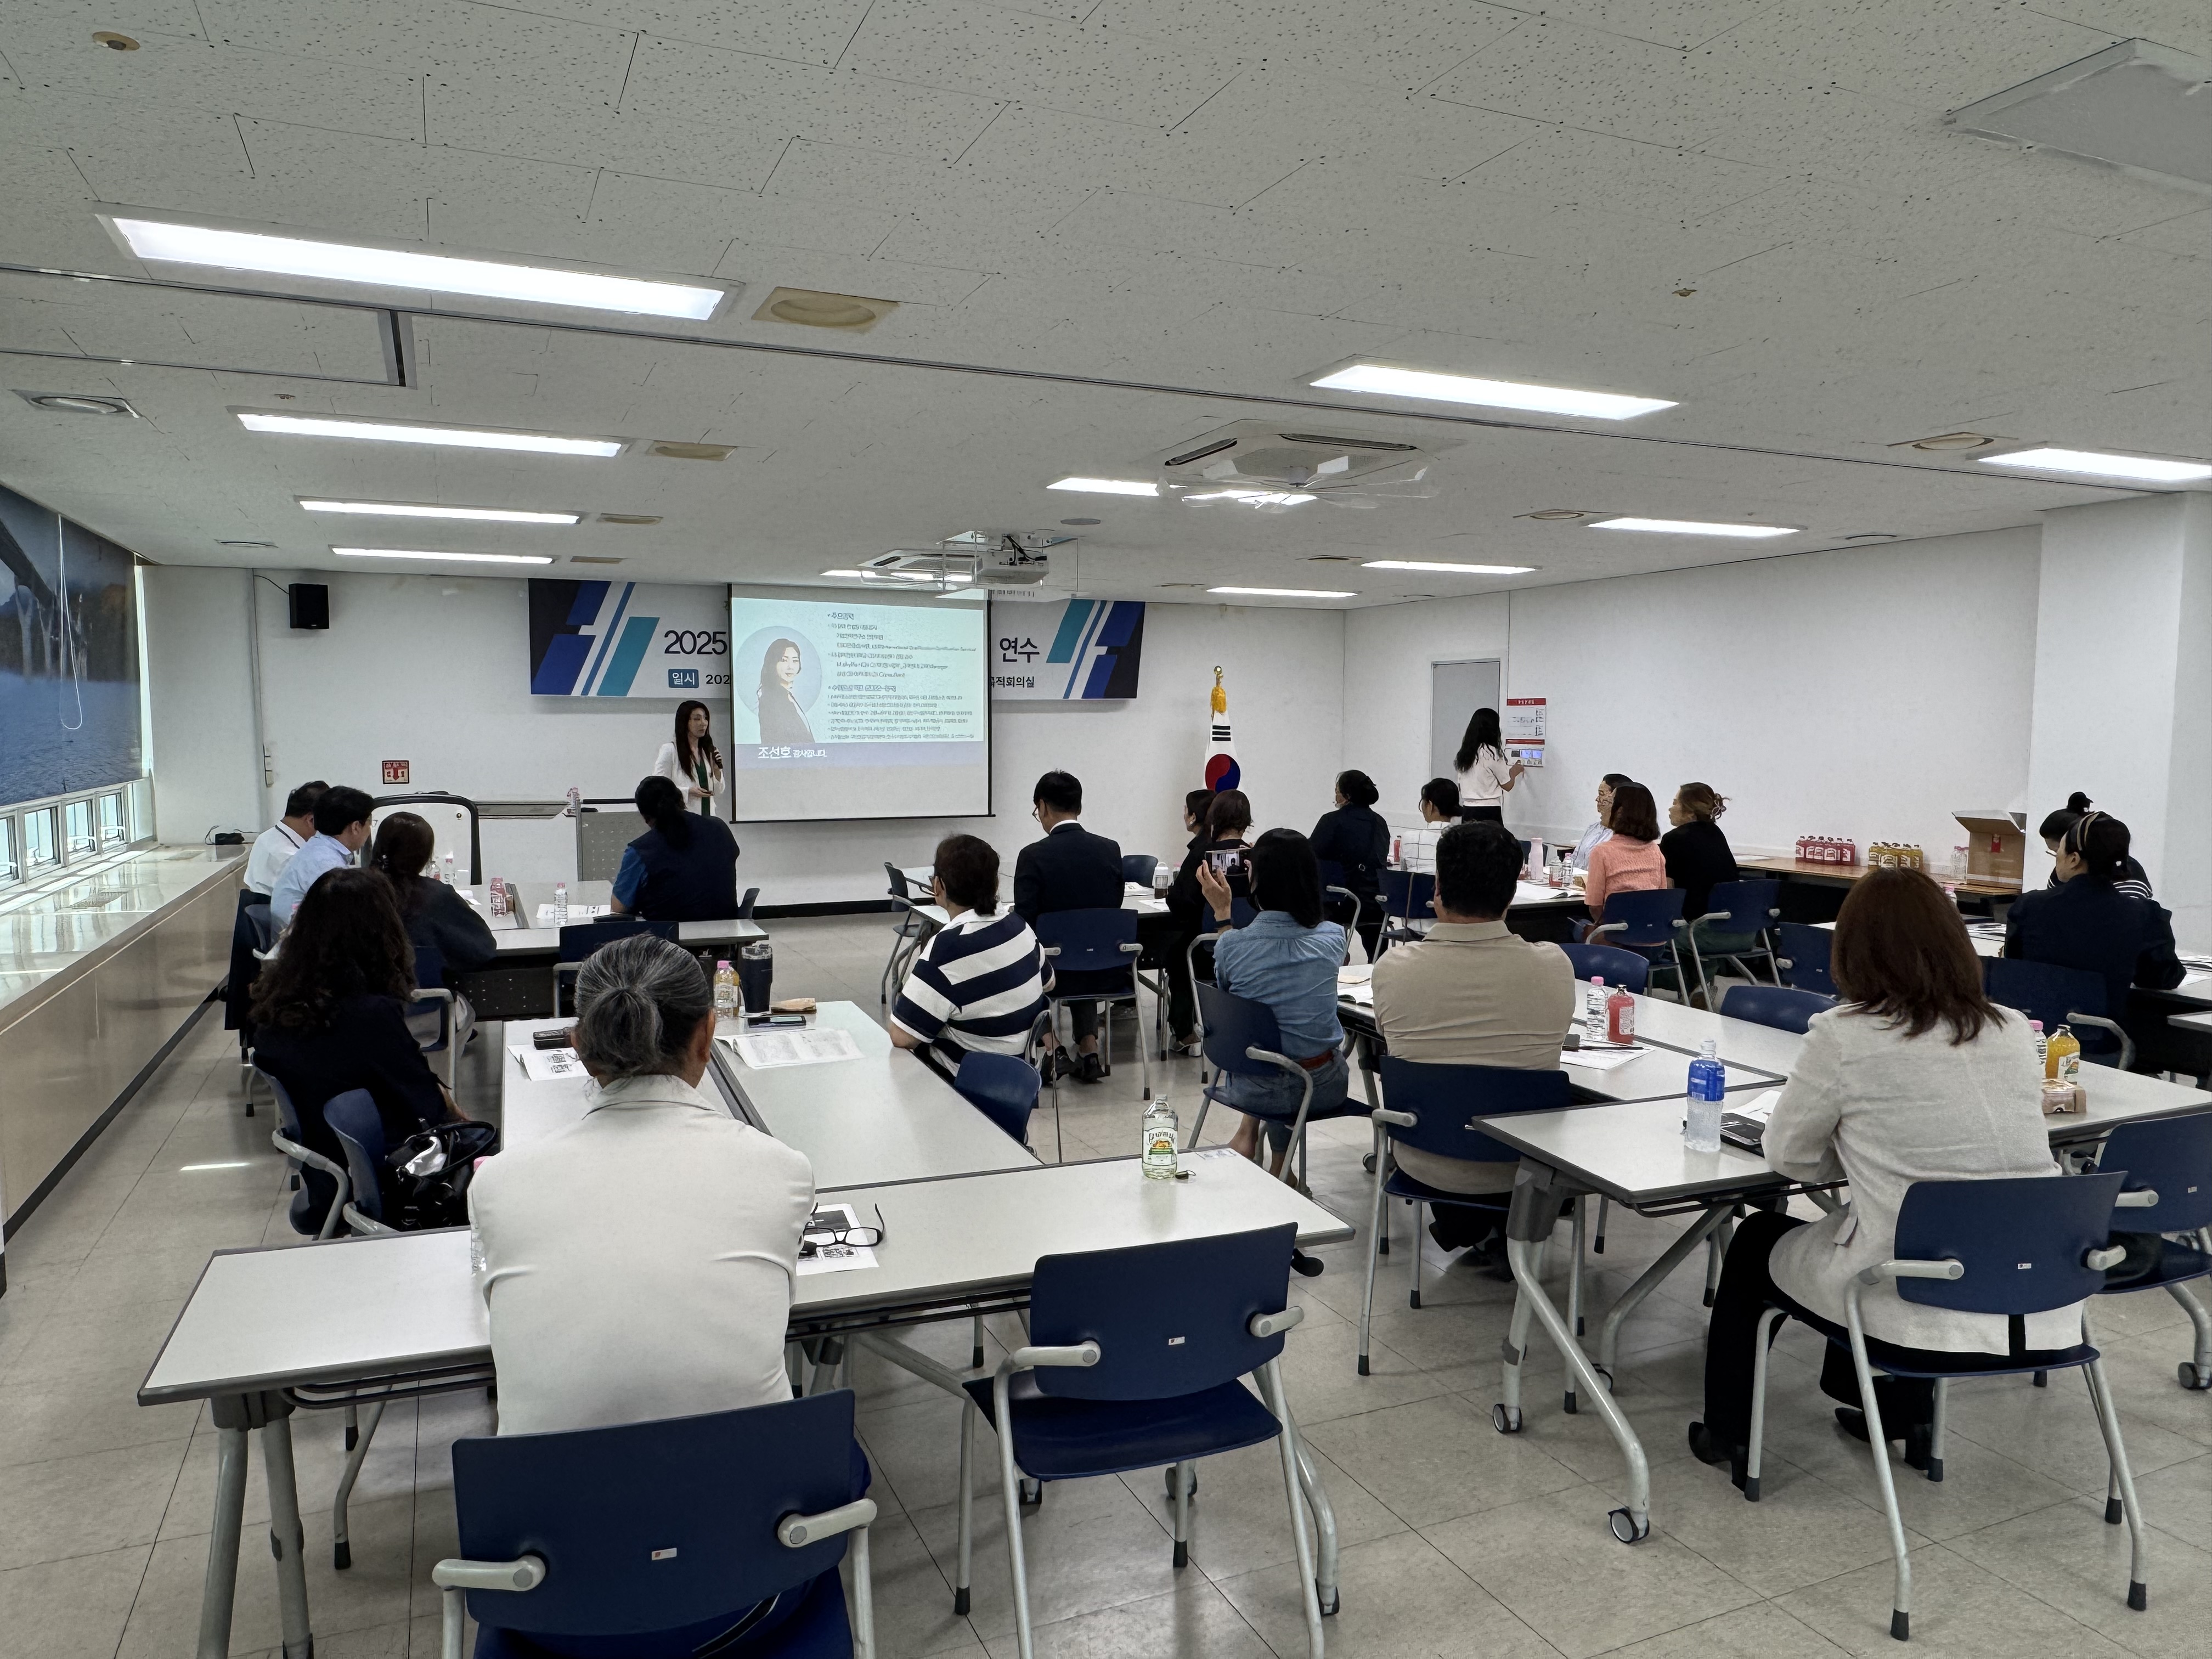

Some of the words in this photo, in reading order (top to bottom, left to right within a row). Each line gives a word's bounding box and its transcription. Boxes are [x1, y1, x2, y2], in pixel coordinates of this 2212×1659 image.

[664, 630, 727, 655] 2025
[1000, 637, 1040, 663] 연수
[672, 672, 695, 685] 일시
